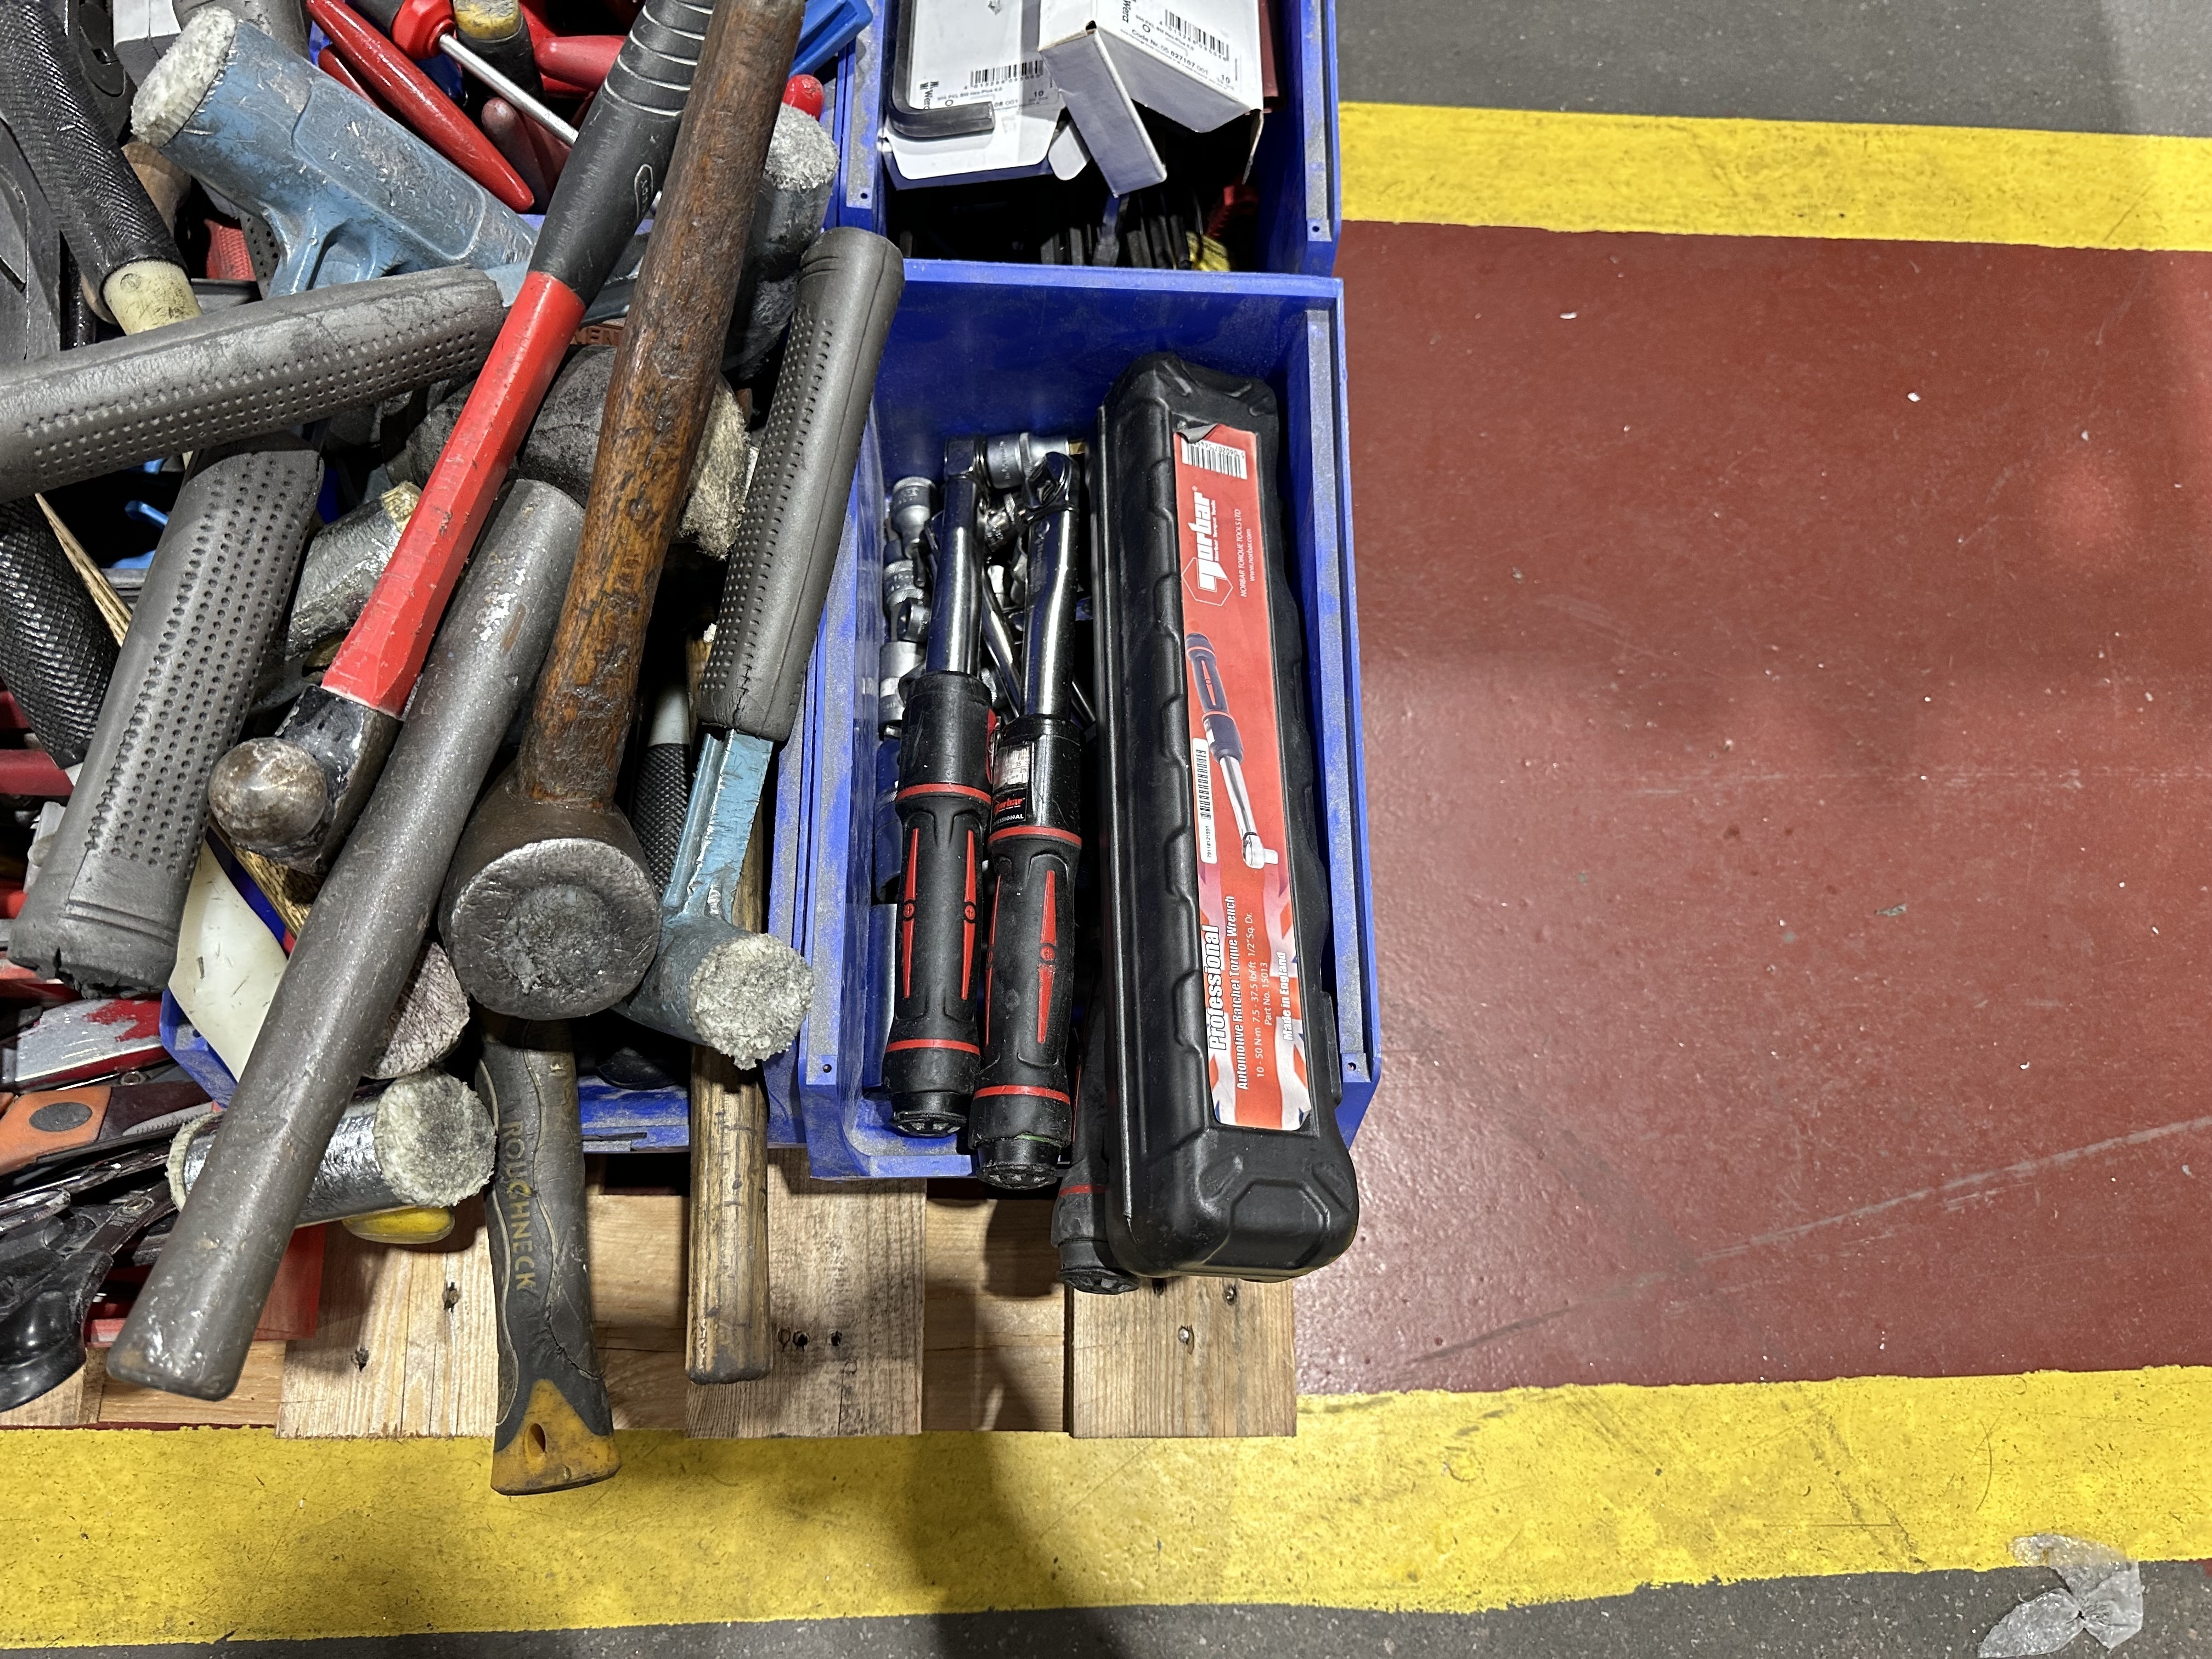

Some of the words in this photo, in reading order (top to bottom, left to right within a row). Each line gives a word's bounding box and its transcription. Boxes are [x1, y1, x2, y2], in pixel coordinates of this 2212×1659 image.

[1132, 30, 1148, 42] Code
[1170, 51, 1195, 67] 027107
[1221, 75, 1230, 83] 10
[1187, 492, 1228, 591] norbar
[1225, 896, 1237, 937] Wrench
[1229, 939, 1240, 977] Torque
[1278, 952, 1289, 995] England
[1203, 926, 1226, 1050] Professional
[1260, 962, 1269, 988] 15013
[1230, 979, 1243, 1022] Ratchet
[1250, 983, 1259, 1001] 37.5
[1262, 991, 1271, 1005] No.
[1280, 997, 1290, 1007] in
[1252, 1009, 1260, 1022] 7.5
[1263, 1007, 1272, 1025] Part
[1282, 1009, 1293, 1040] Made
[1235, 1025, 1248, 1090] Automotive
[1255, 1047, 1263, 1059] 50
[1256, 1066, 1264, 1077] 10
[503, 1121, 536, 1290] ROUGHNECK
